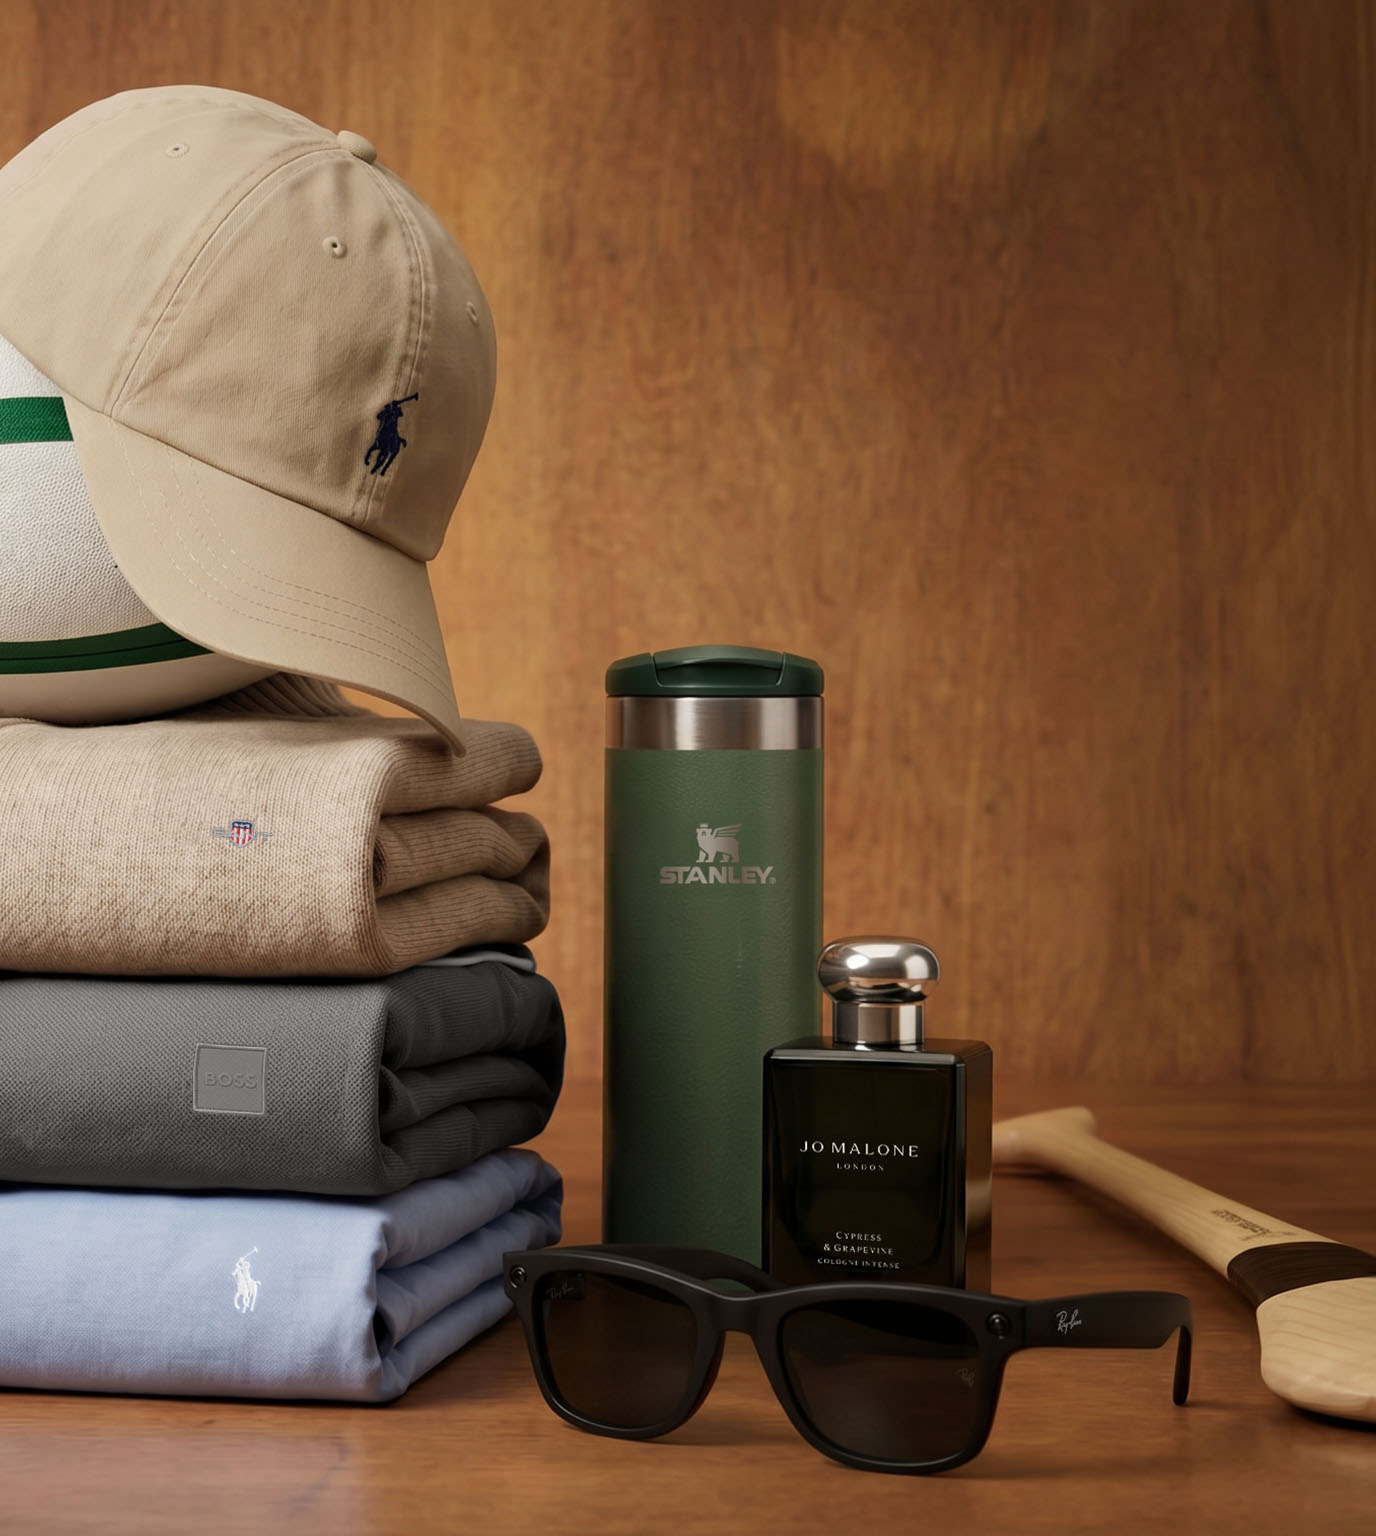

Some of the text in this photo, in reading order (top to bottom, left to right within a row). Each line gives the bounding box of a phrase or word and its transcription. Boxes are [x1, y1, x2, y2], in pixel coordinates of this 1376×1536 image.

[204, 1071, 257, 1090] BOSS
[799, 1140, 919, 1158] JO MALONE
[836, 1162, 885, 1172] LONDON
[835, 1231, 883, 1242] CYPRESS
[823, 1243, 894, 1256] & GRAPEVINE
